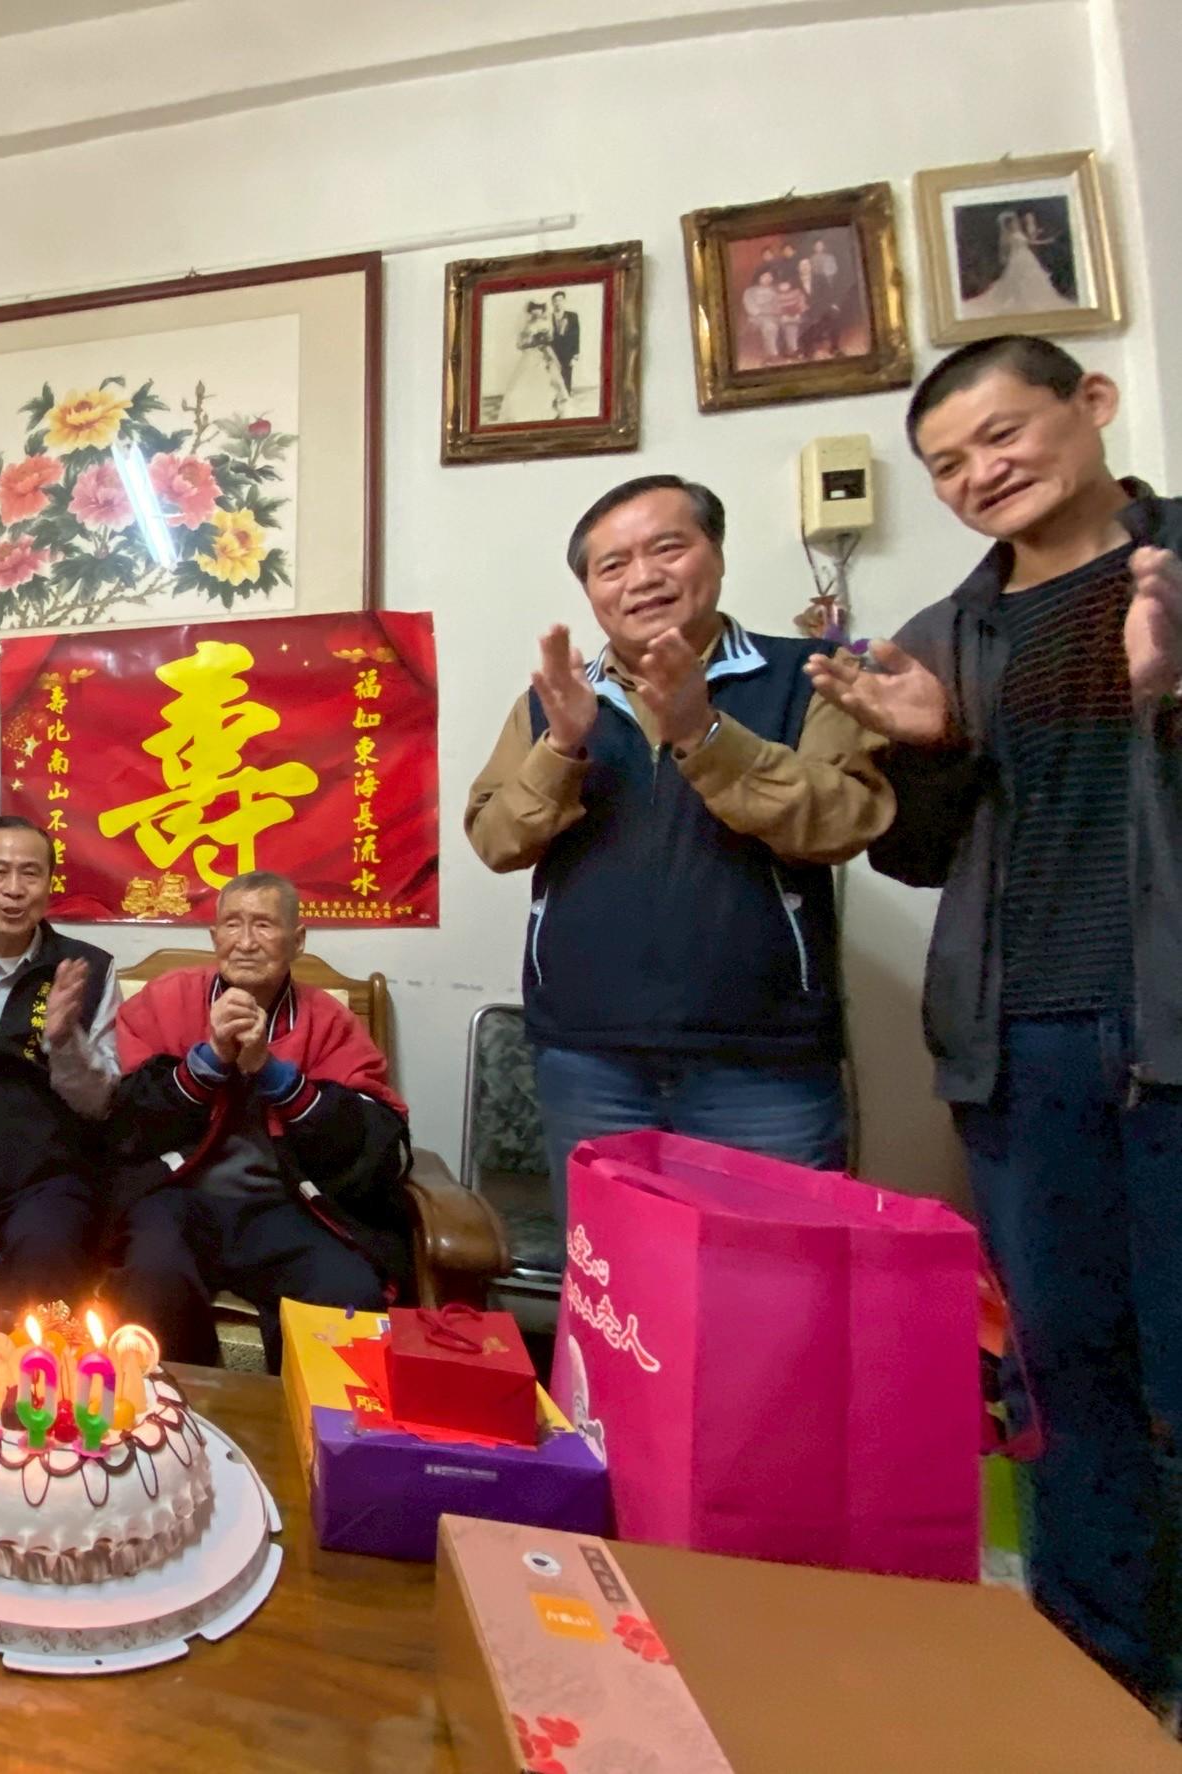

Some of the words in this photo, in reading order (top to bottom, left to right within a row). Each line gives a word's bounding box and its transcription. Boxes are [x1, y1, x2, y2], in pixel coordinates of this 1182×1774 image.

[350, 668, 382, 897] 福如東海長流水
